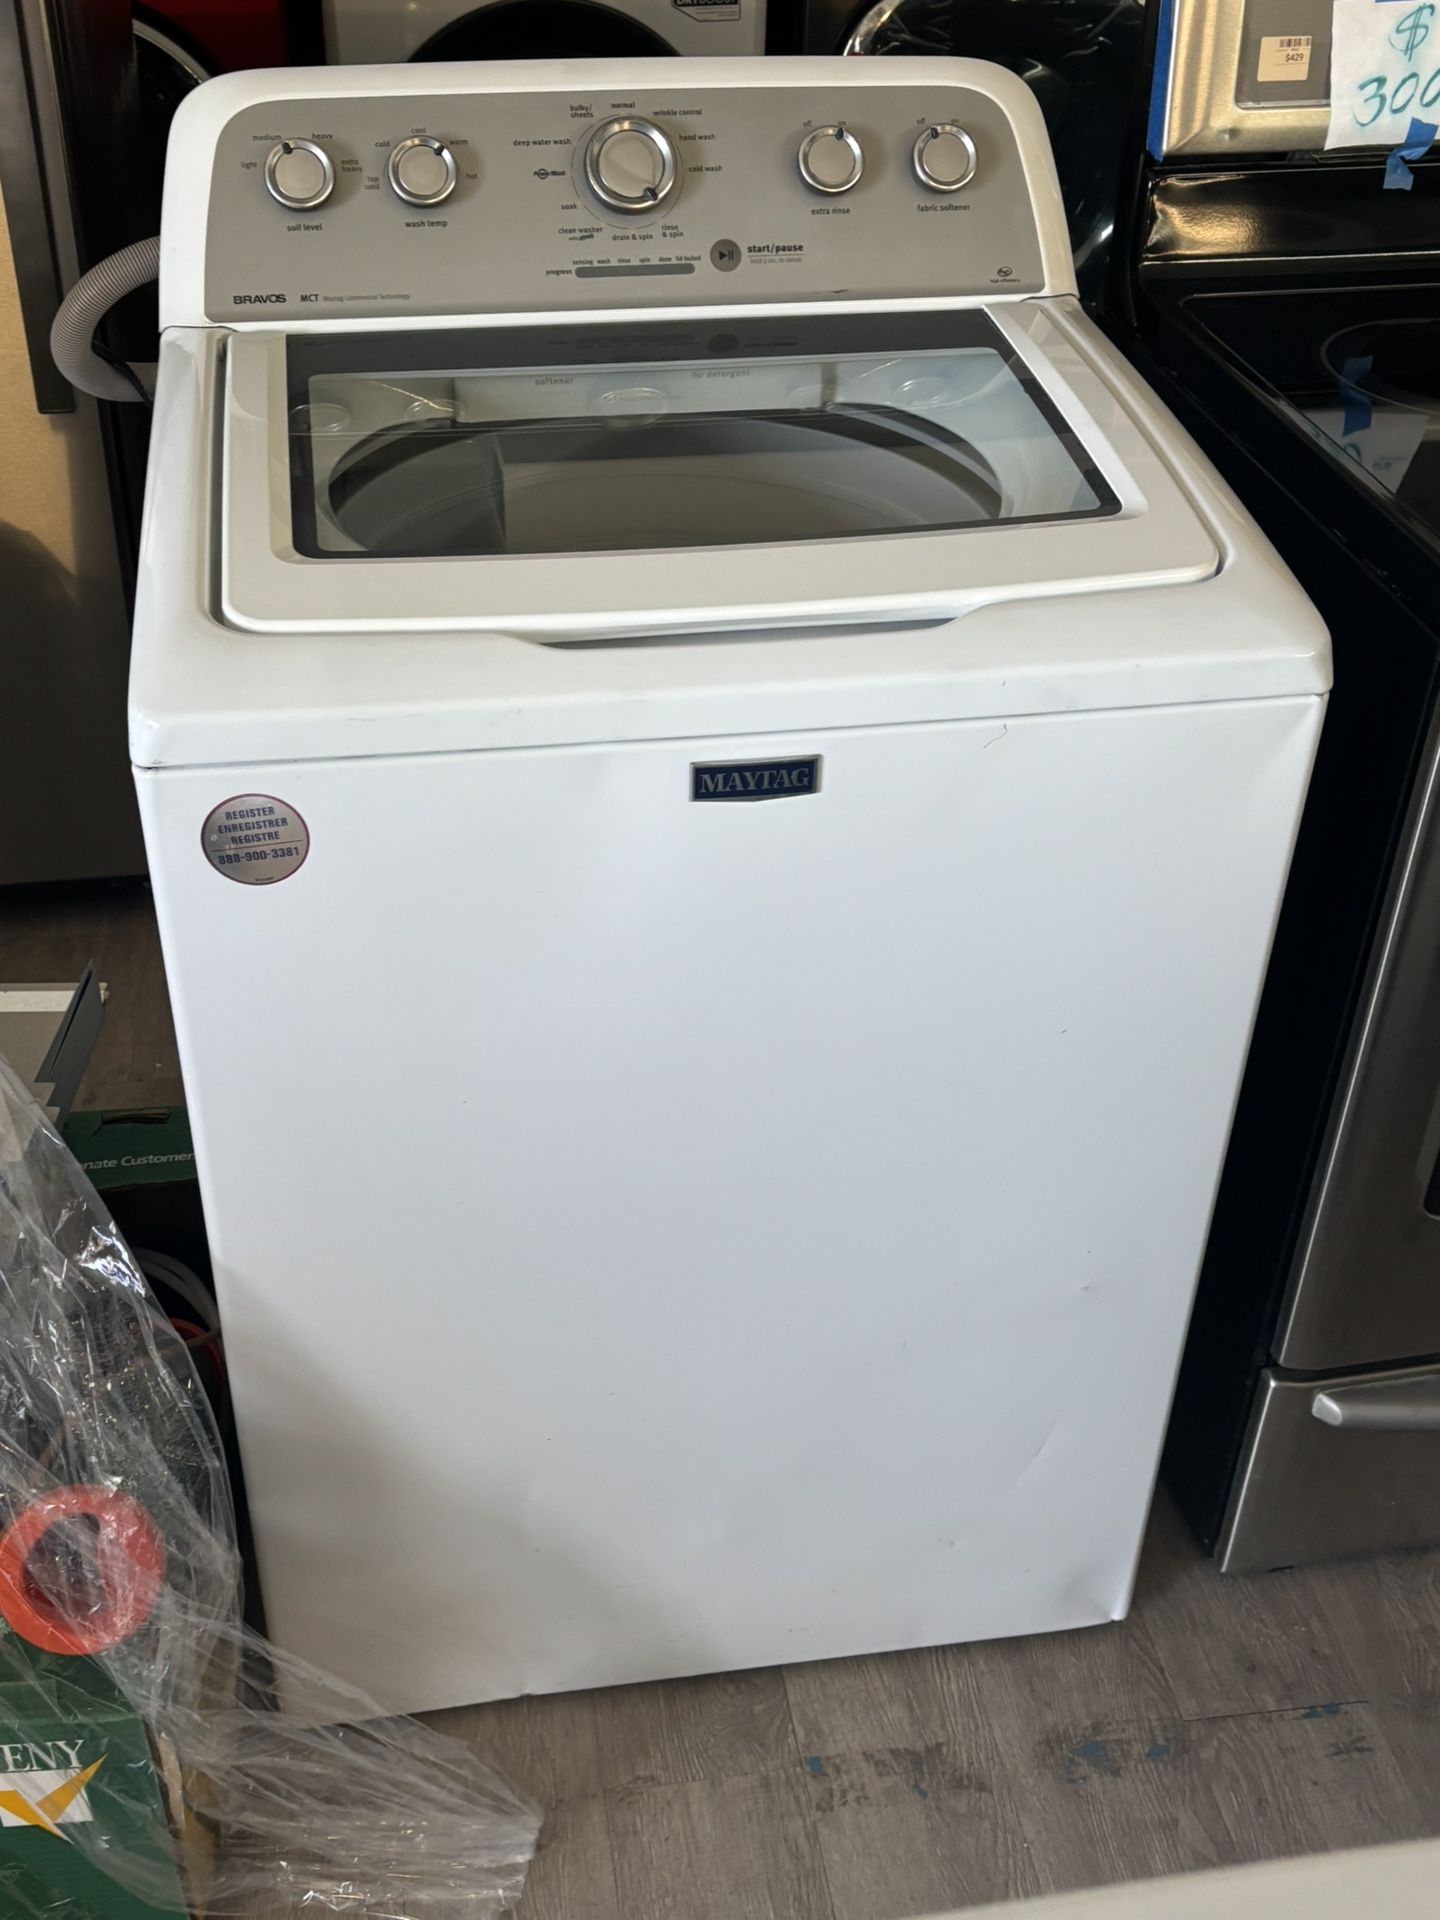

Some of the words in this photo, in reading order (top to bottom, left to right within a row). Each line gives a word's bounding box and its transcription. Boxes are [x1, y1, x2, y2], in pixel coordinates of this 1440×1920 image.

[1388, 3, 1434, 62] $
[570, 104, 592, 112] bulky/
[252, 133, 282, 141] medium
[312, 132, 333, 140] heavy
[375, 140, 390, 148] cold
[513, 139, 531, 147] deep
[241, 161, 257, 169] light
[341, 165, 363, 173] heavy
[368, 175, 380, 183] tap
[811, 207, 830, 215] extra
[832, 207, 851, 215] rinse
[917, 203, 939, 212] fabric
[940, 203, 971, 212] softener
[286, 223, 302, 232] soil
[303, 223, 323, 231] level
[405, 220, 426, 228] wash
[427, 219, 448, 229] temp
[578, 225, 603, 233] washer
[638, 233, 654, 241] spin
[747, 243, 804, 254] start/pause
[233, 294, 287, 304] BRAVOS
[300, 294, 318, 302] MCT
[706, 369, 751, 380] detergent
[535, 377, 574, 386] softener
[700, 768, 811, 793] MAYTAG
[225, 806, 275, 821] REGISTER
[217, 817, 288, 834] ENREGISTRER
[230, 831, 280, 845] REGISTRE
[218, 846, 300, 865] 888-900-3381
